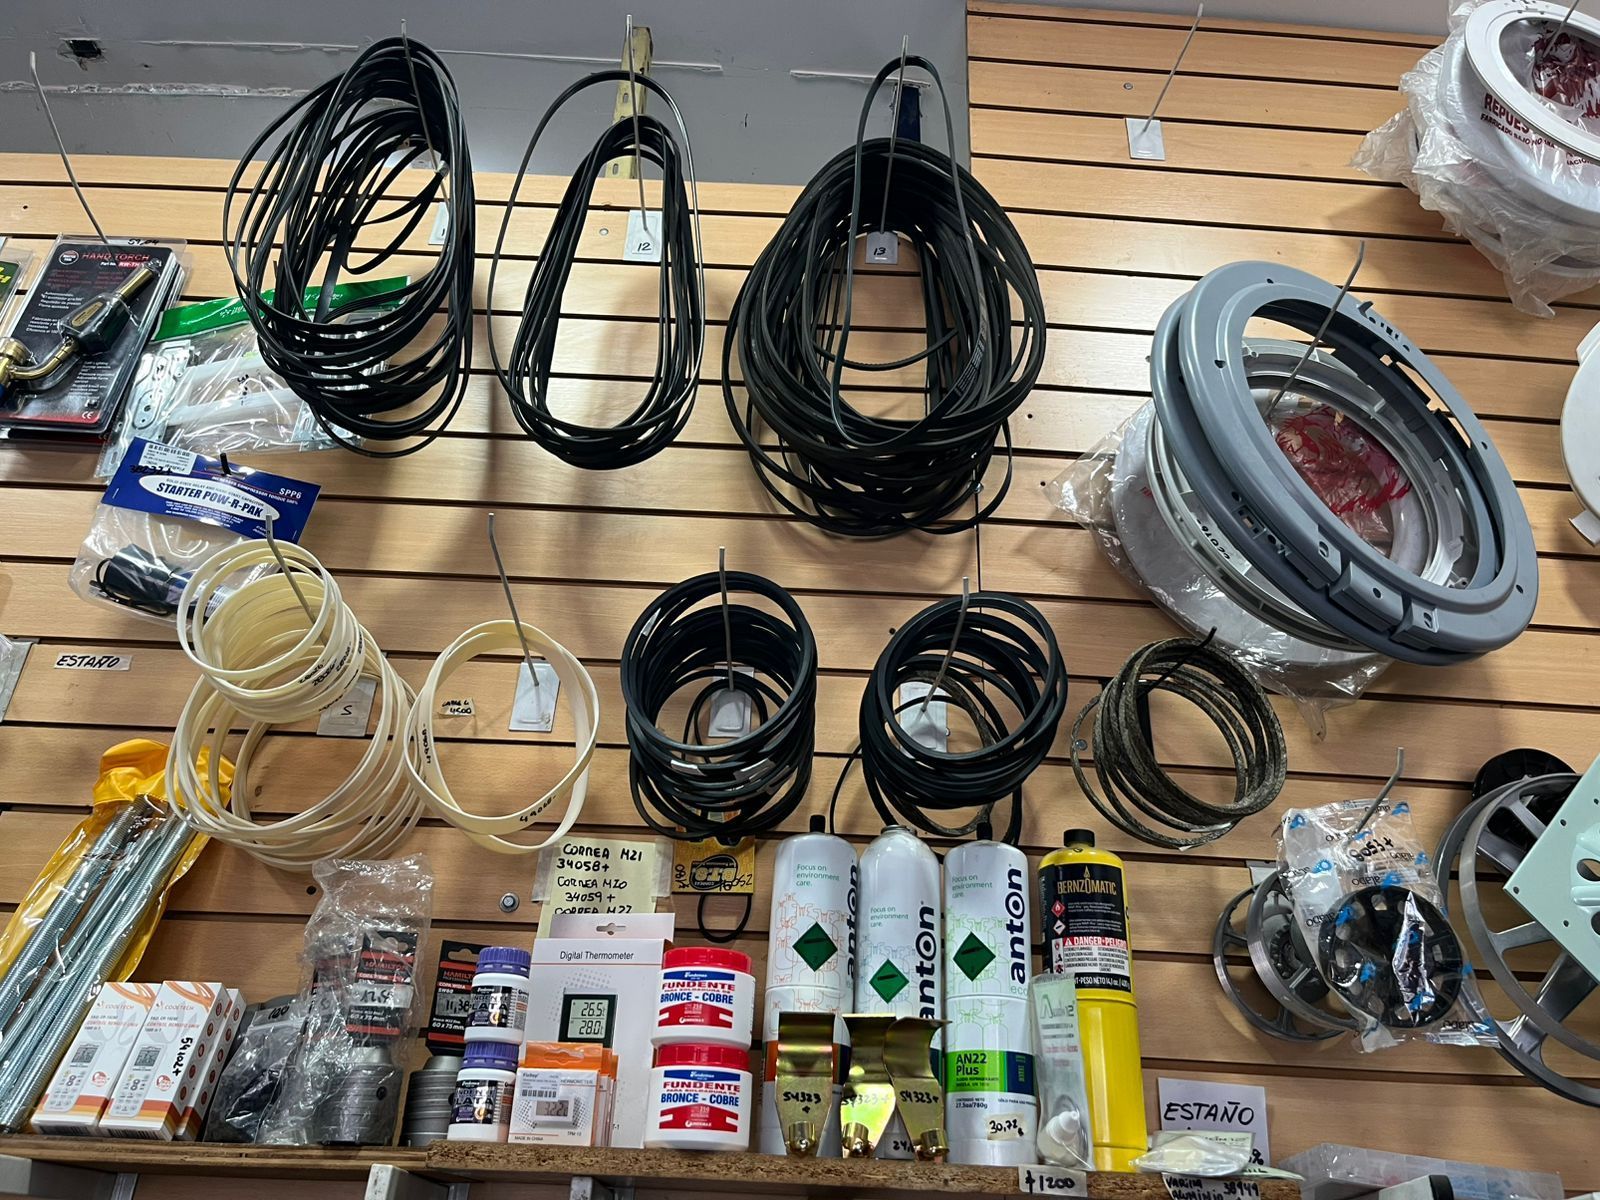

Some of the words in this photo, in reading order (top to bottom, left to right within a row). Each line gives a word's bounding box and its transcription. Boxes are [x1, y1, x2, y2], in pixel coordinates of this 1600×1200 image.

[1484, 93, 1530, 134] REPUES
[636, 242, 652, 252] 12
[873, 246, 887, 256] 13
[115, 252, 150, 260] TORCH
[156, 482, 203, 499] STARTER
[279, 487, 302, 499] SPP6
[796, 863, 816, 872] Focus
[817, 864, 828, 872] on
[796, 872, 841, 882] environment
[951, 875, 968, 883] Focus
[951, 881, 993, 891] environment
[1057, 875, 1117, 896] BERNZOMATIC
[870, 906, 887, 914] Focus
[870, 912, 910, 921] environment
[1004, 867, 1025, 984] anton
[1073, 935, 1102, 946] DANGER
[559, 951, 584, 962] Digital
[584, 950, 635, 961] Thermometer
[443, 970, 474, 979] HAMILT
[661, 981, 736, 992] FUNDENTE
[660, 991, 693, 1003] BRONCE
[702, 991, 734, 1005] COBRE
[956, 1052, 987, 1064] AN22
[956, 1064, 980, 1076] Plus
[663, 1081, 741, 1093] FUNDENTE
[660, 1092, 699, 1103] BRONCE
[709, 1094, 740, 1107] COBRE
[783, 1091, 822, 1104] 54323
[1164, 1101, 1254, 1126] ESTAÑO
